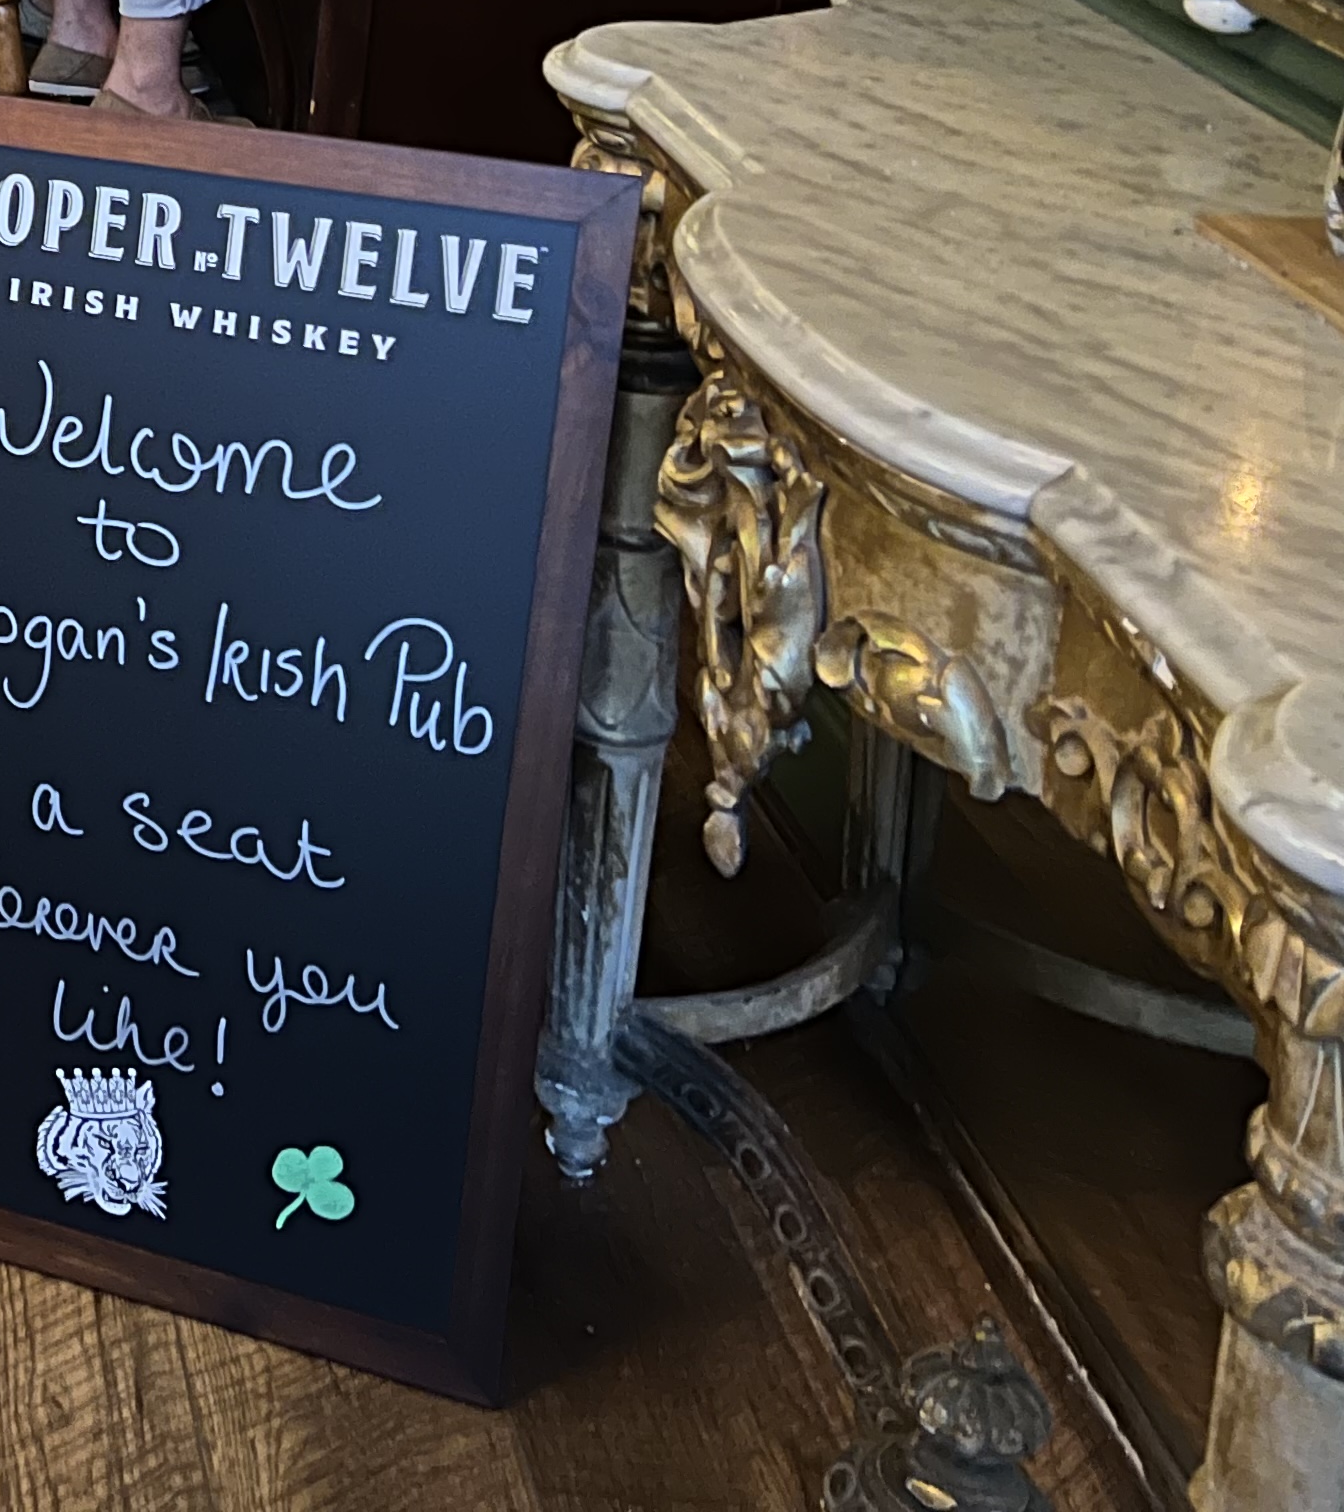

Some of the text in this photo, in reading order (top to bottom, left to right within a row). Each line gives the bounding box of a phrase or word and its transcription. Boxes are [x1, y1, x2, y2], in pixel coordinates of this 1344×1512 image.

[215, 202, 542, 324] TWELVE
[8, 277, 397, 361] IRISH WHISKEY
[76, 499, 181, 567] to
[364, 616, 494, 756] Pub
[31, 782, 85, 837] a
[122, 792, 346, 889] seat
[246, 947, 400, 1034] you
